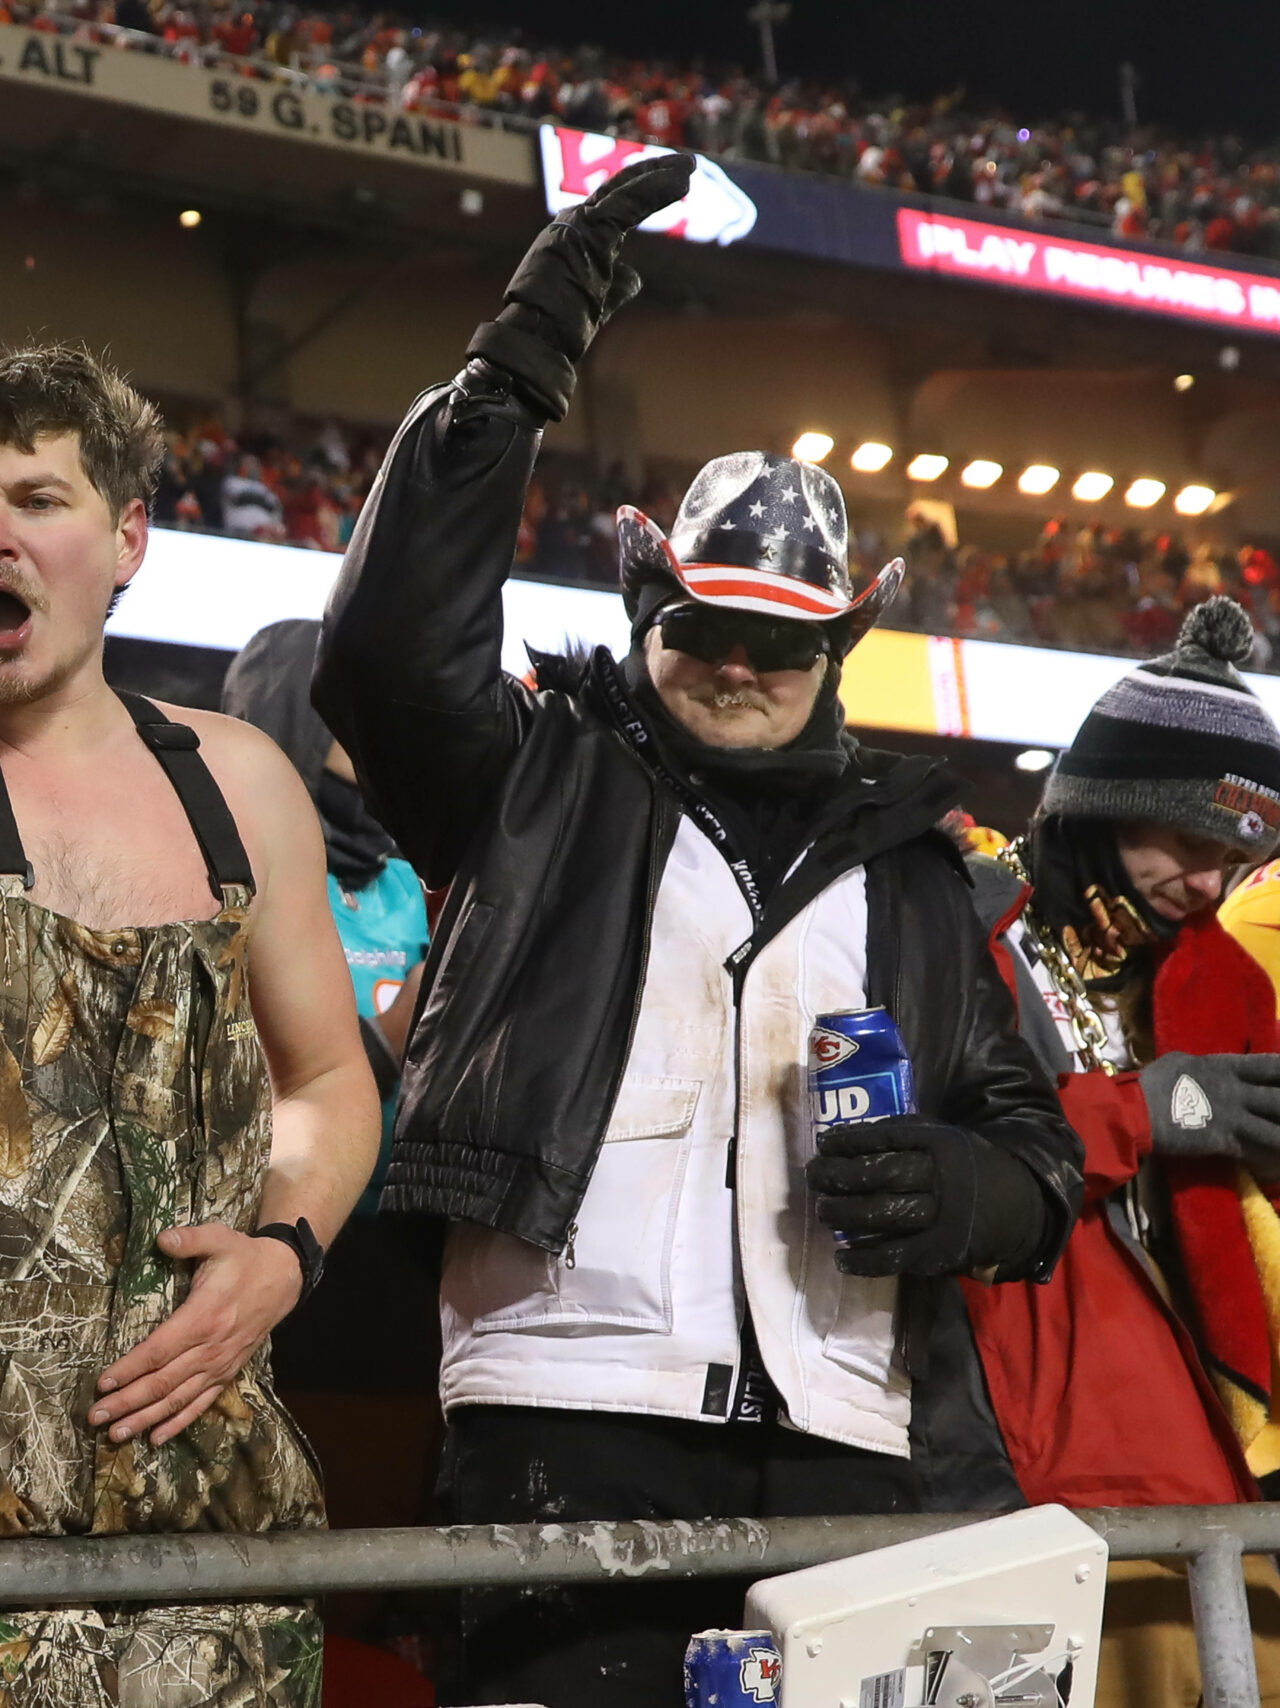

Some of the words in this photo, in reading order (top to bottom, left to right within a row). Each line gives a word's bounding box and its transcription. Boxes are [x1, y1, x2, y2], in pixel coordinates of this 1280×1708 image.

[20, 36, 102, 84] ALT
[209, 78, 261, 117] 59
[273, 91, 320, 133] G.
[331, 103, 464, 163] SPANI
[916, 221, 1036, 276] PLAY
[1043, 245, 1247, 316] RESUMES
[1224, 772, 1258, 793] SUPER
[810, 1086, 870, 1122] UD
